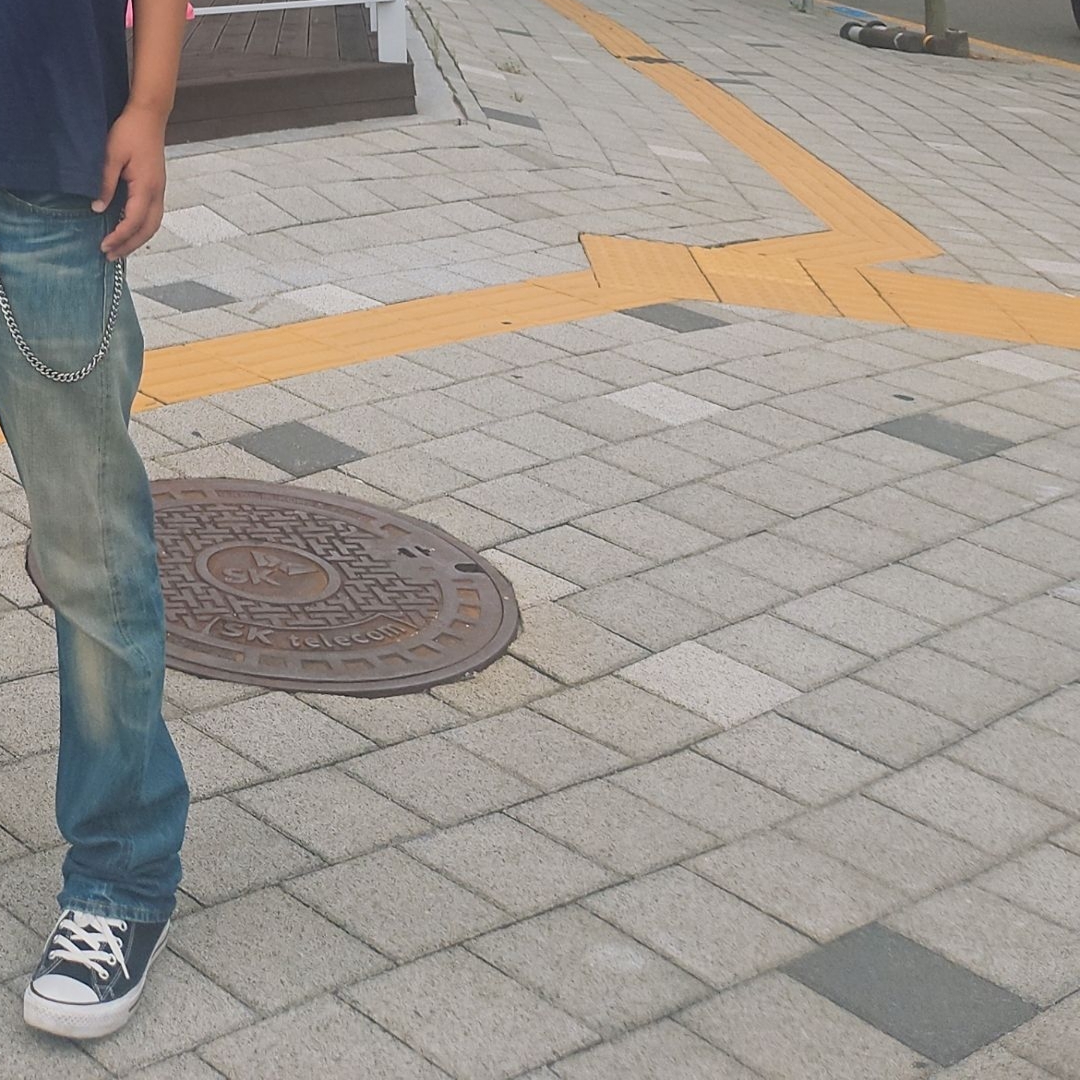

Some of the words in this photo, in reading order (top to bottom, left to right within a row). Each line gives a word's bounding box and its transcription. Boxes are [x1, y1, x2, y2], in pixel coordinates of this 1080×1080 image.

[222, 568, 281, 587] SK
[222, 618, 274, 645] SK
[289, 620, 407, 649] telecom
